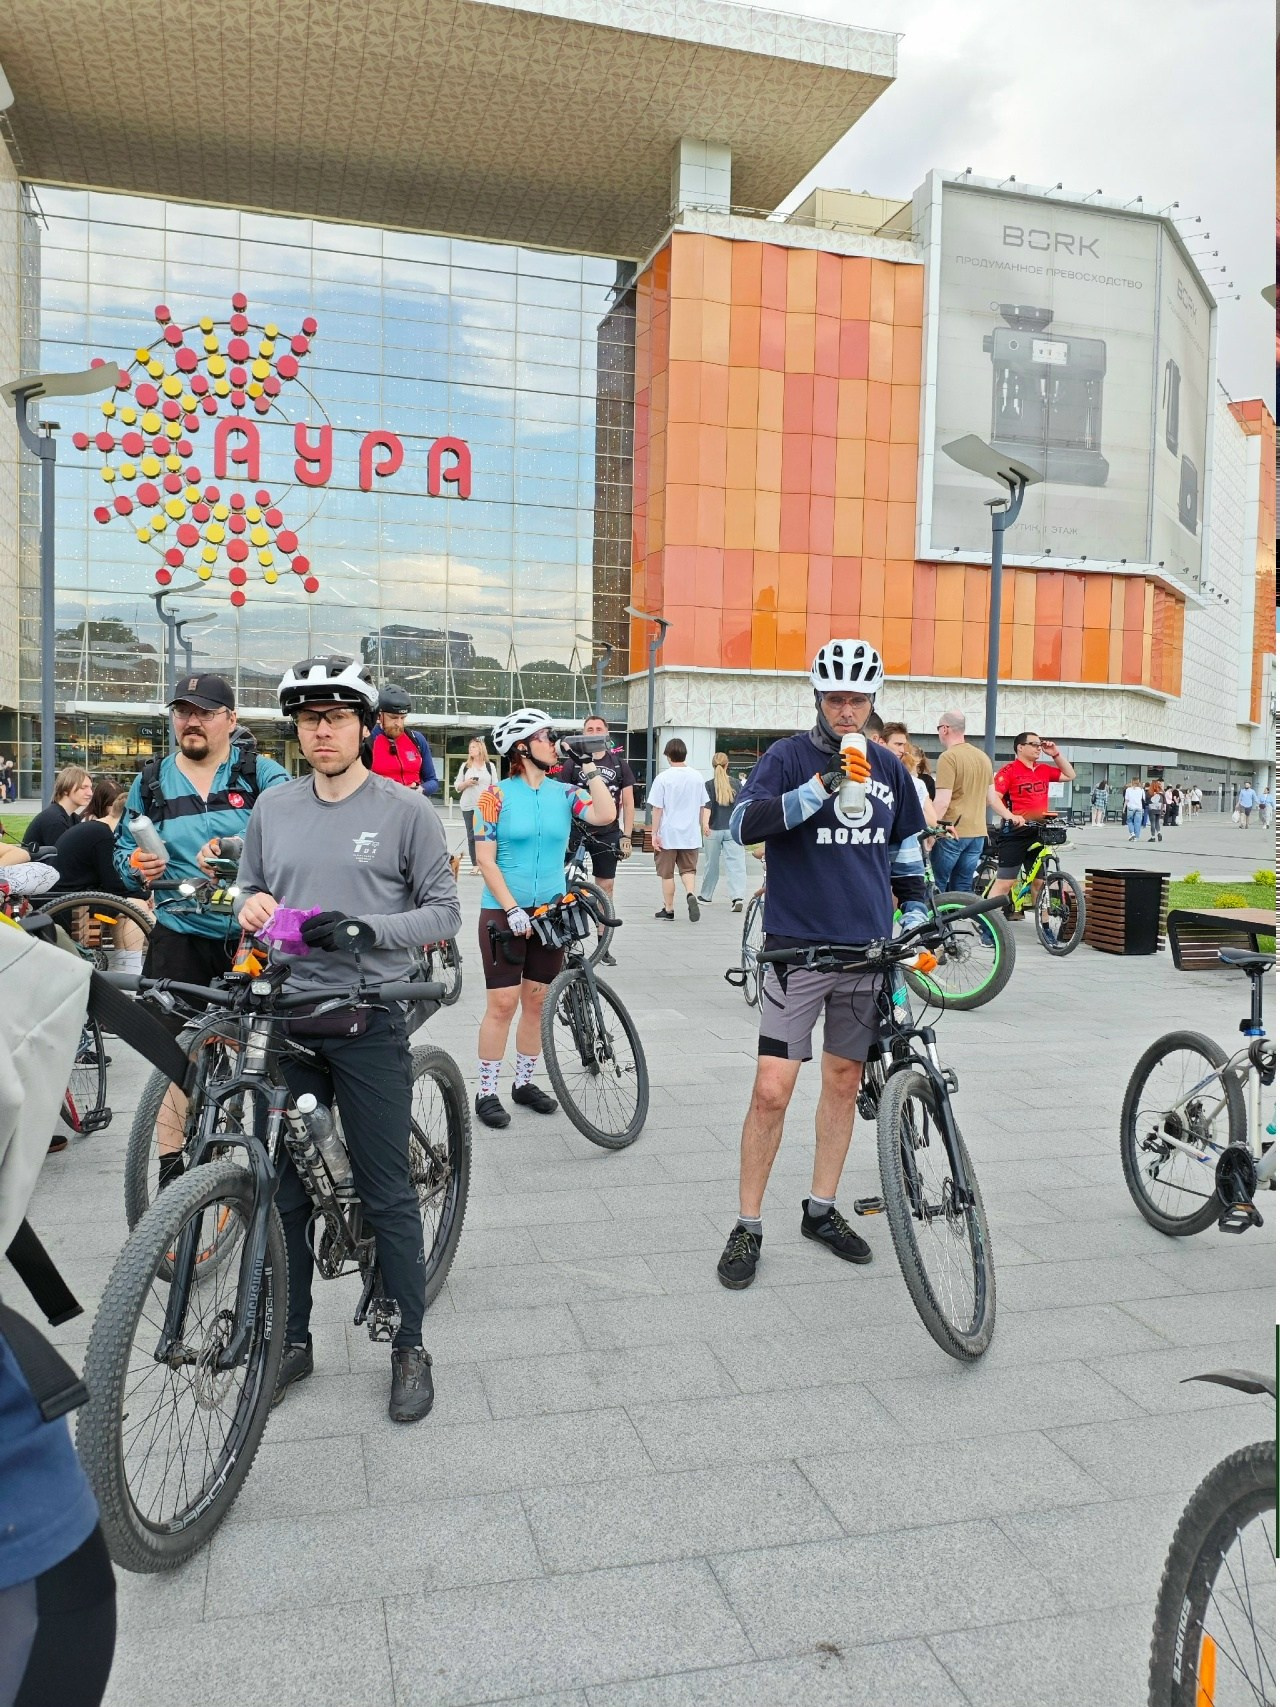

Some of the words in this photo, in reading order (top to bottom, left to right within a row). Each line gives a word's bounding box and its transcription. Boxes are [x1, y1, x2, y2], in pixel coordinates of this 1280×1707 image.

[1003, 225, 1100, 259] BORK
[955, 255, 1043, 275] ПРОДУМАННОЕ
[1046, 268, 1143, 290] ПРЕВОСХОДСТВО
[213, 415, 472, 500] АУРА
[816, 827, 886, 845] ROMA
